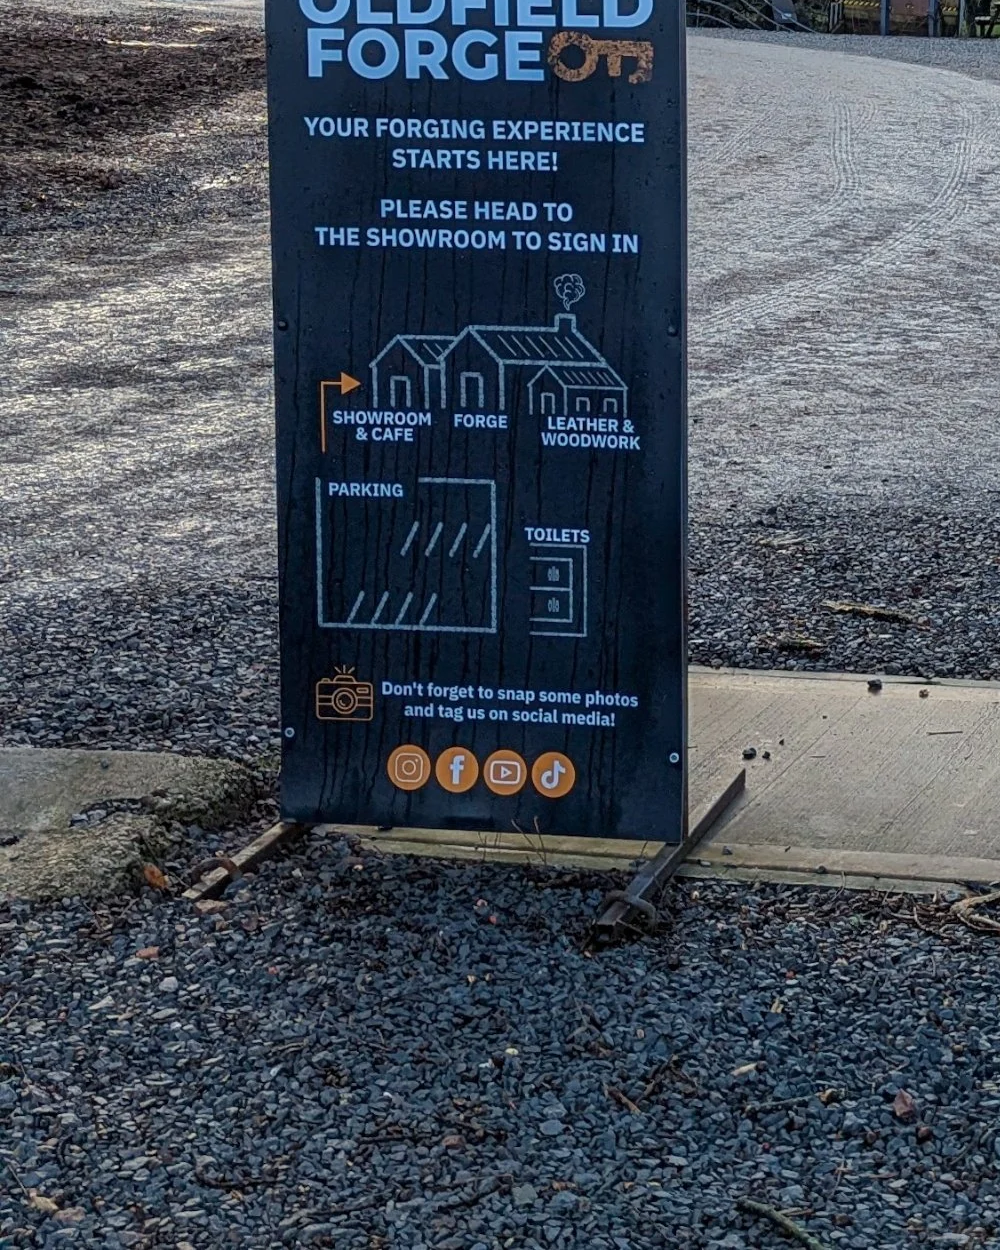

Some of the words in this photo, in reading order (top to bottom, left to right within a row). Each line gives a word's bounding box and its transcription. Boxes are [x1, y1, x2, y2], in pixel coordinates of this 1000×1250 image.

[306, 27, 545, 82] FORGE
[303, 116, 369, 138] YOUR
[375, 118, 486, 140] FORGING
[492, 120, 645, 143] EXPERIENCE
[392, 148, 481, 170] STARTS
[487, 150, 559, 172] HERE!
[380, 198, 468, 220] PLEASE
[474, 200, 538, 221] HEAD
[542, 202, 573, 223] TO
[314, 226, 361, 247] THE
[366, 227, 506, 250] SHOWROOM
[511, 230, 542, 251] TO
[547, 231, 606, 253] SIGN
[611, 233, 639, 254] IN
[332, 410, 432, 426] SHOWROOM
[453, 413, 508, 429] FORGE
[547, 415, 619, 433] LEATHER
[622, 418, 635, 434] &
[355, 426, 368, 441] &
[371, 426, 414, 442] CAFE
[540, 431, 641, 451] WOODWORK
[328, 481, 404, 498] PARKING
[524, 526, 590, 543] TOILETS
[381, 681, 424, 697] Don't
[426, 682, 475, 702] forget
[477, 685, 494, 700] to
[497, 688, 536, 705] snap
[538, 690, 582, 705] some
[585, 690, 639, 708] photos
[404, 702, 434, 718] and
[437, 704, 464, 723] tag
[466, 707, 486, 721] us
[488, 709, 509, 722] on
[511, 707, 559, 724] social
[561, 710, 616, 727] media!
